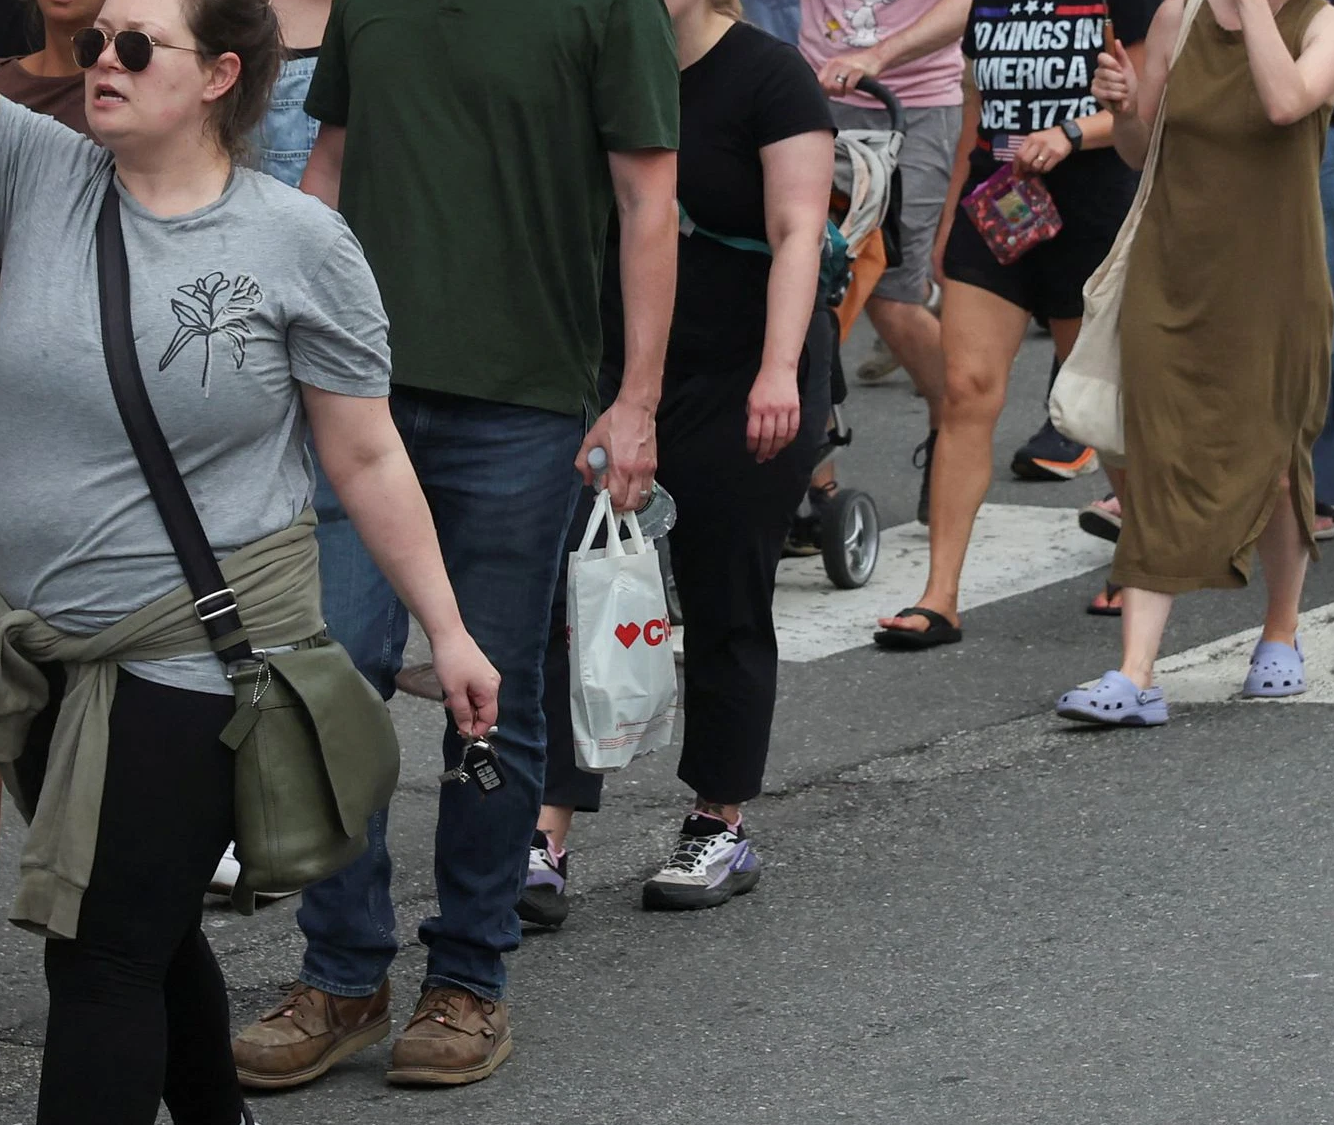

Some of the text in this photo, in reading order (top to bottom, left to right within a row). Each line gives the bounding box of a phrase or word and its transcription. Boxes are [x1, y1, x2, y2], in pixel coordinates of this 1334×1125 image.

[974, 17, 1103, 51] O KINGS IN
[973, 55, 1088, 91] MERICA
[1027, 95, 1097, 130] 1776
